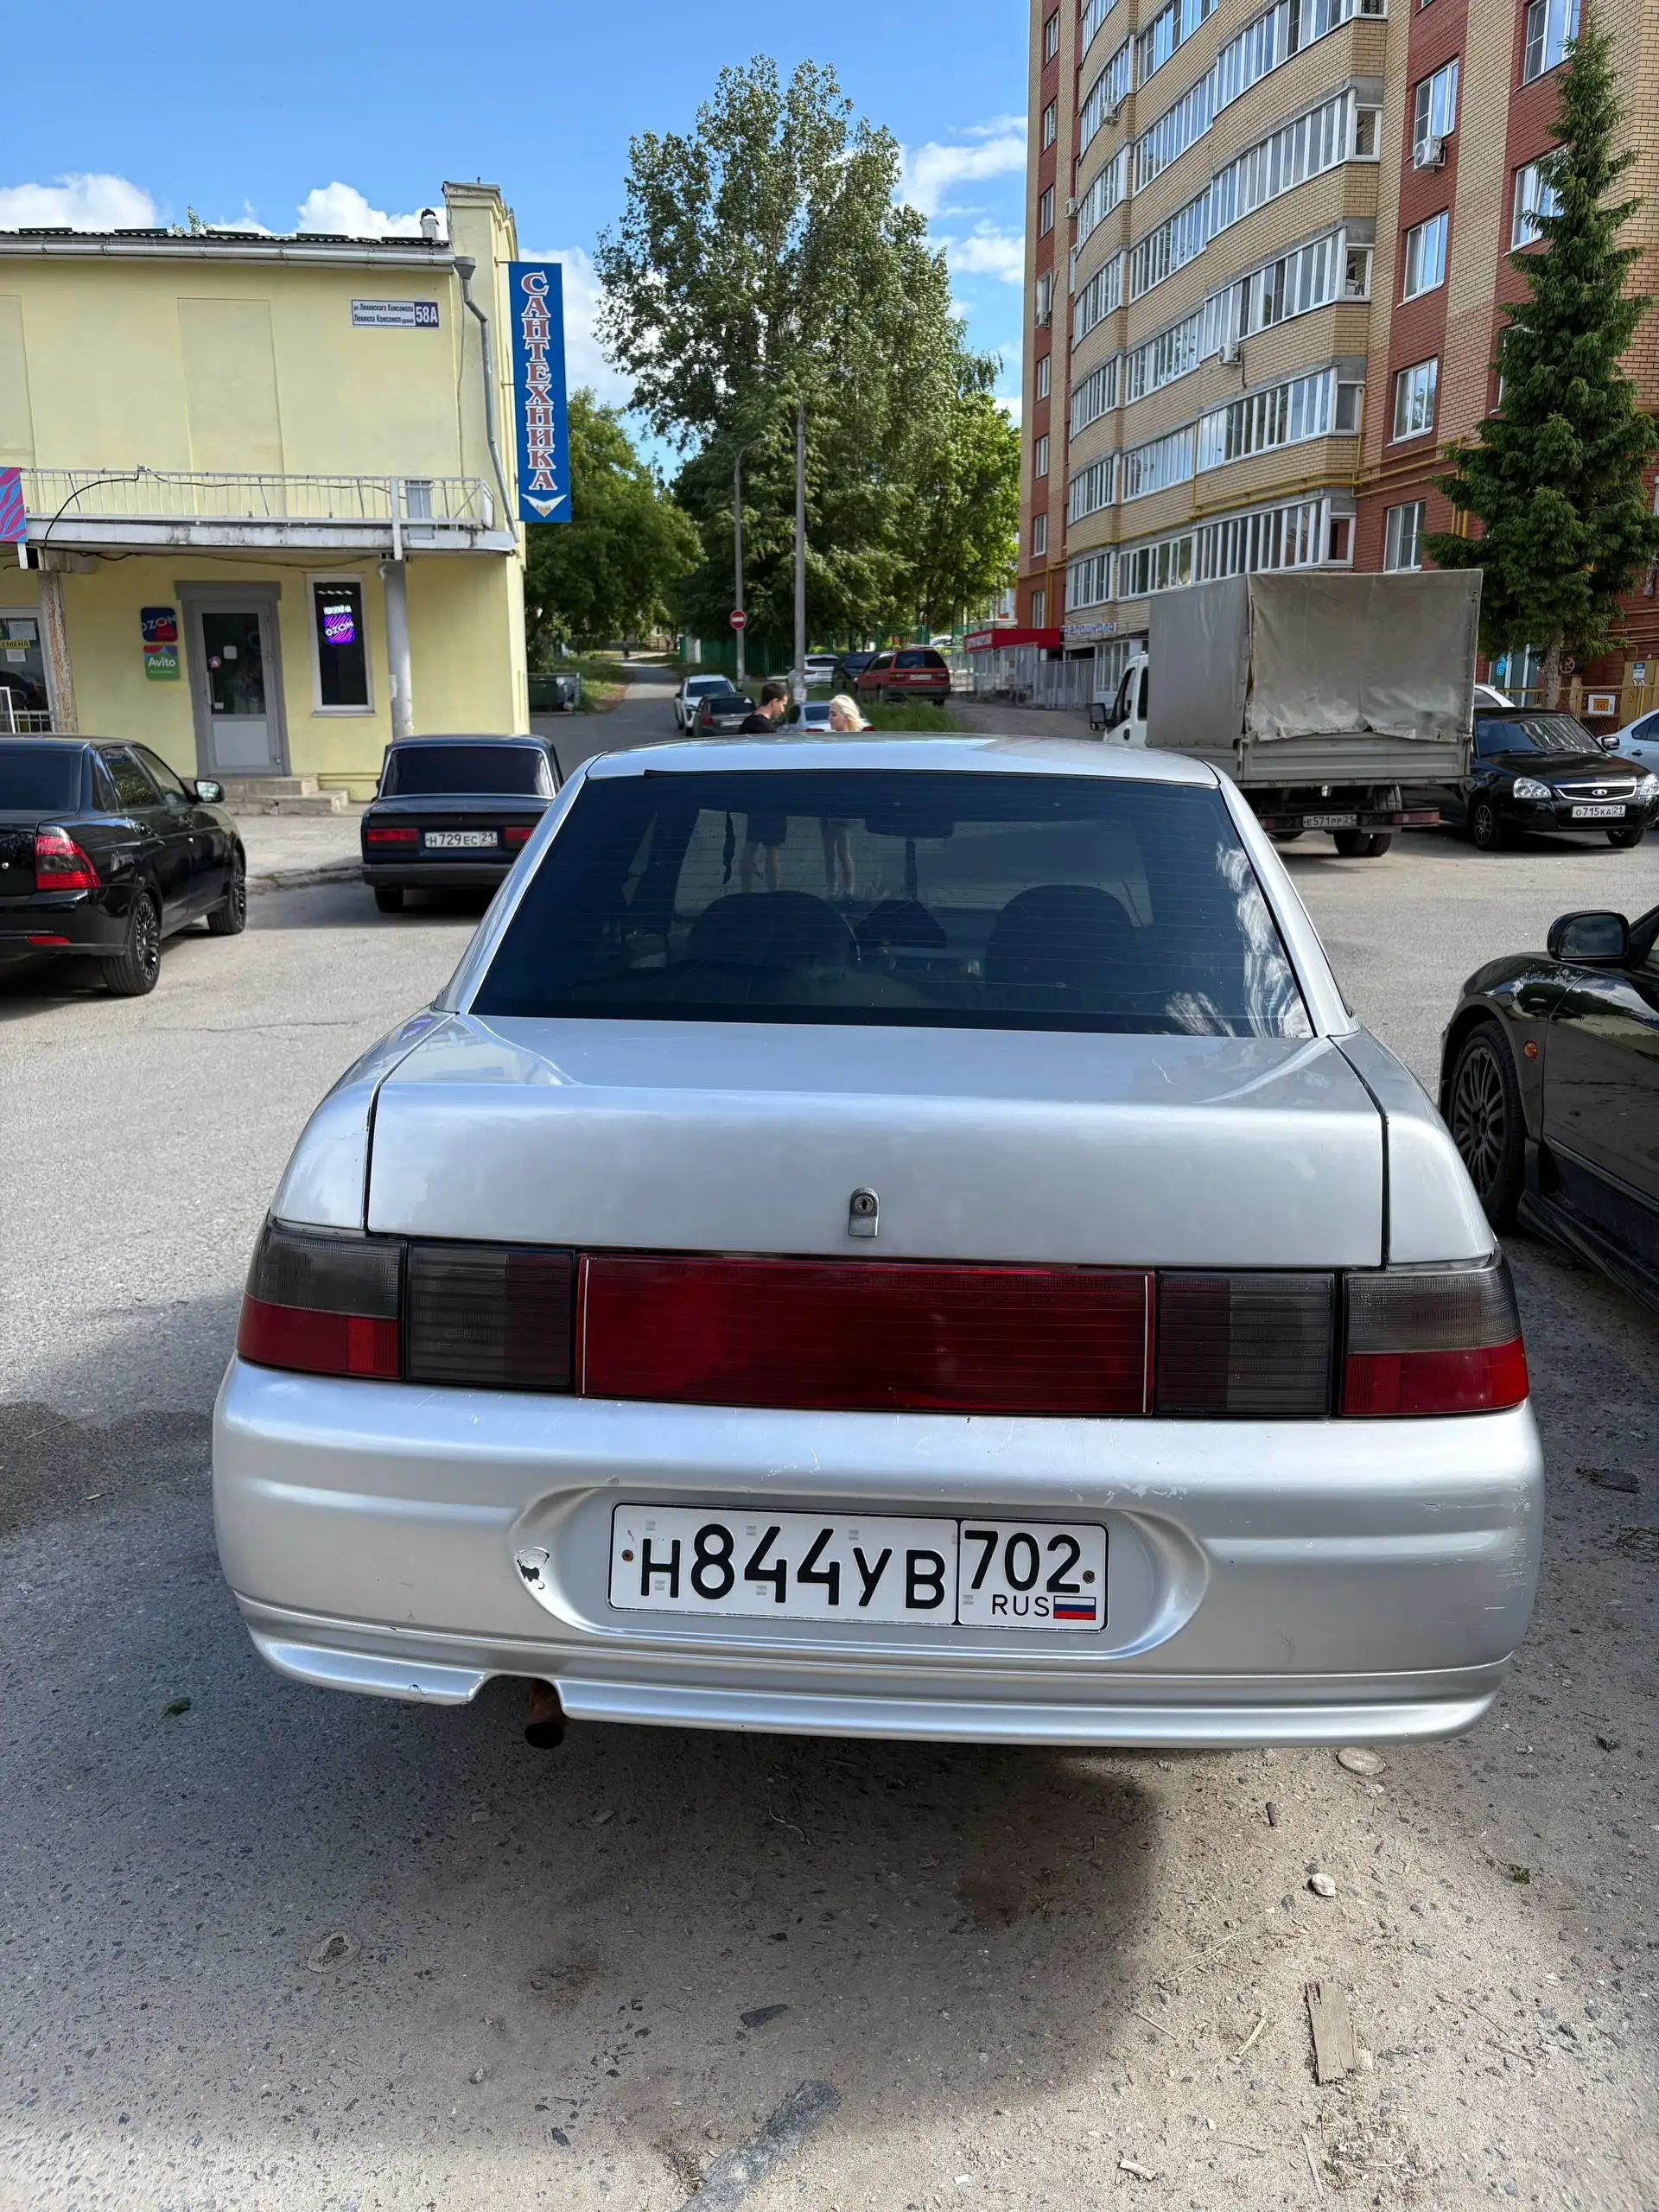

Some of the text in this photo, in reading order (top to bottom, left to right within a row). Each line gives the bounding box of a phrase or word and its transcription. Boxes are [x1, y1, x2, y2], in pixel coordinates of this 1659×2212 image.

[416, 306, 438, 323] 58А
[521, 270, 558, 491] САНТЕХНИКА
[142, 615, 176, 631] OZON
[325, 620, 354, 637] OZON
[149, 657, 176, 667] Avito
[481, 832, 493, 842] 21
[640, 1522, 1081, 1610] Н844УВ 702
[992, 1593, 1050, 1618] RUS
